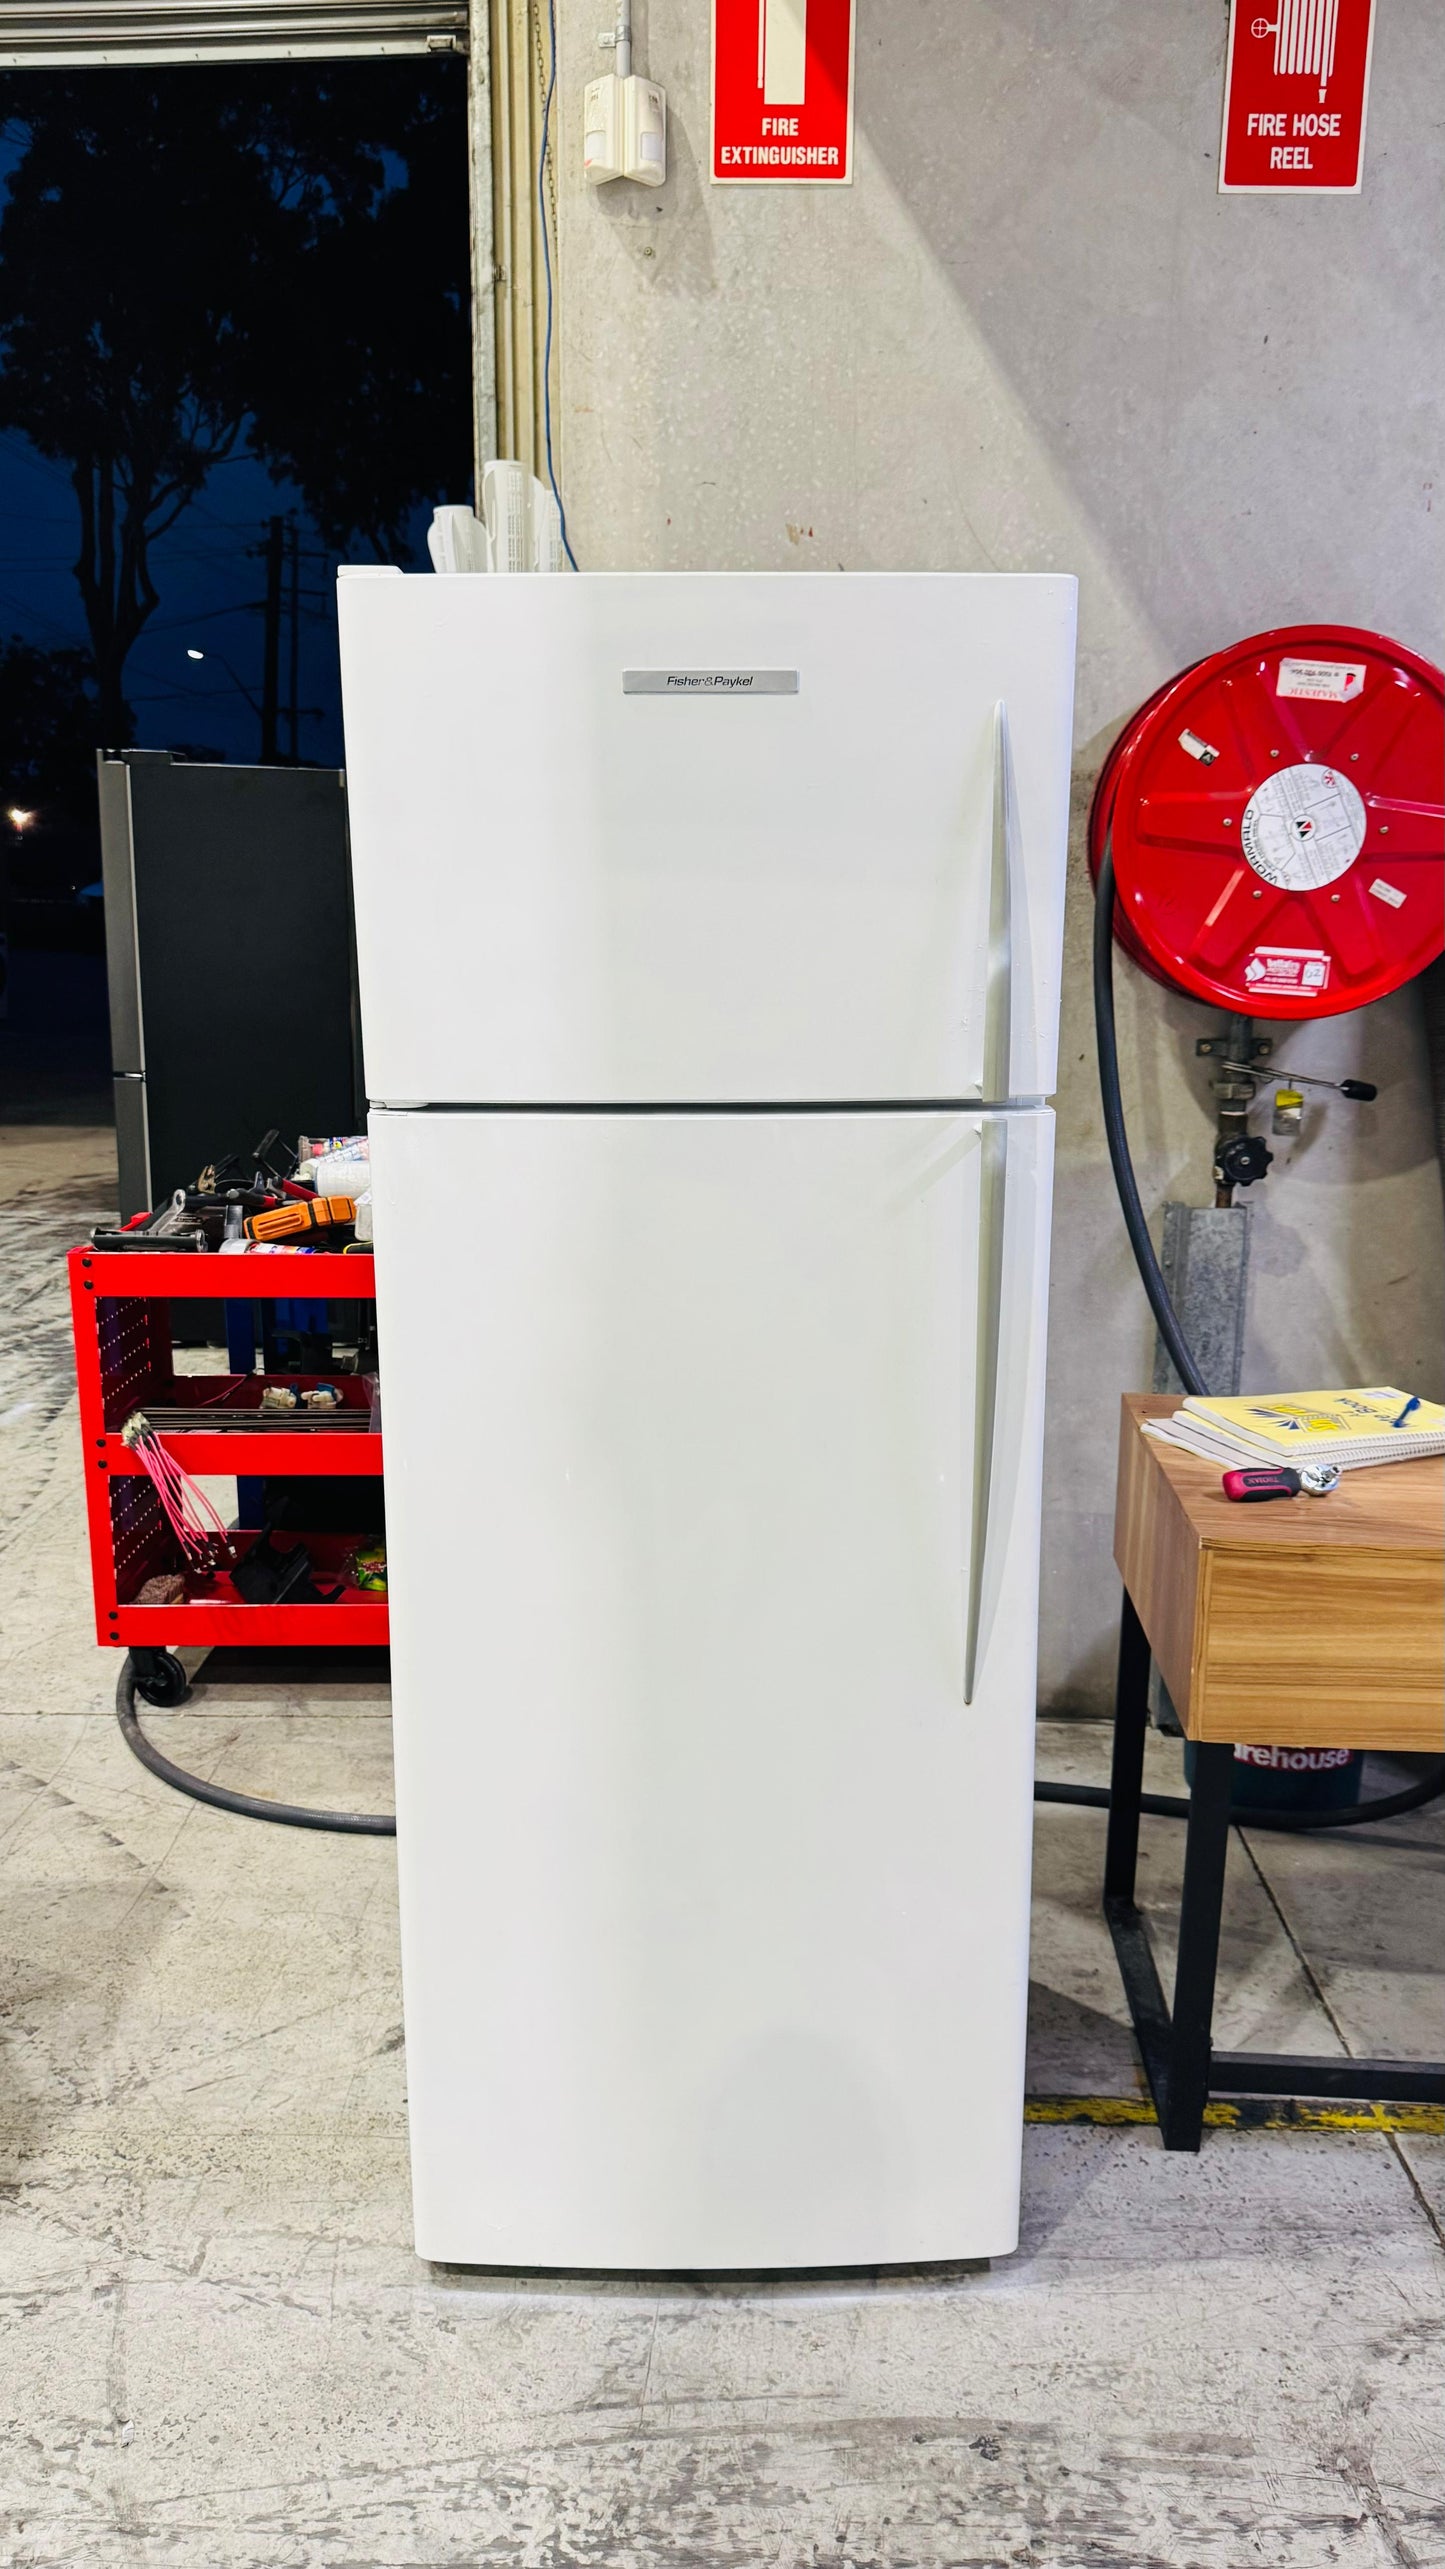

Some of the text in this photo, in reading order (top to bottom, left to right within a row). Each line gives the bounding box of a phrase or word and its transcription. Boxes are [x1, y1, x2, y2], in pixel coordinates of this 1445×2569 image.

[762, 117, 799, 136] FIRE
[1247, 113, 1342, 137] FIRE HOSE
[720, 146, 839, 165] EXTINGUISHER
[1270, 146, 1313, 170] REEL
[667, 676, 753, 688] Fisher&Paykel
[1242, 809, 1278, 885] WORMALD
